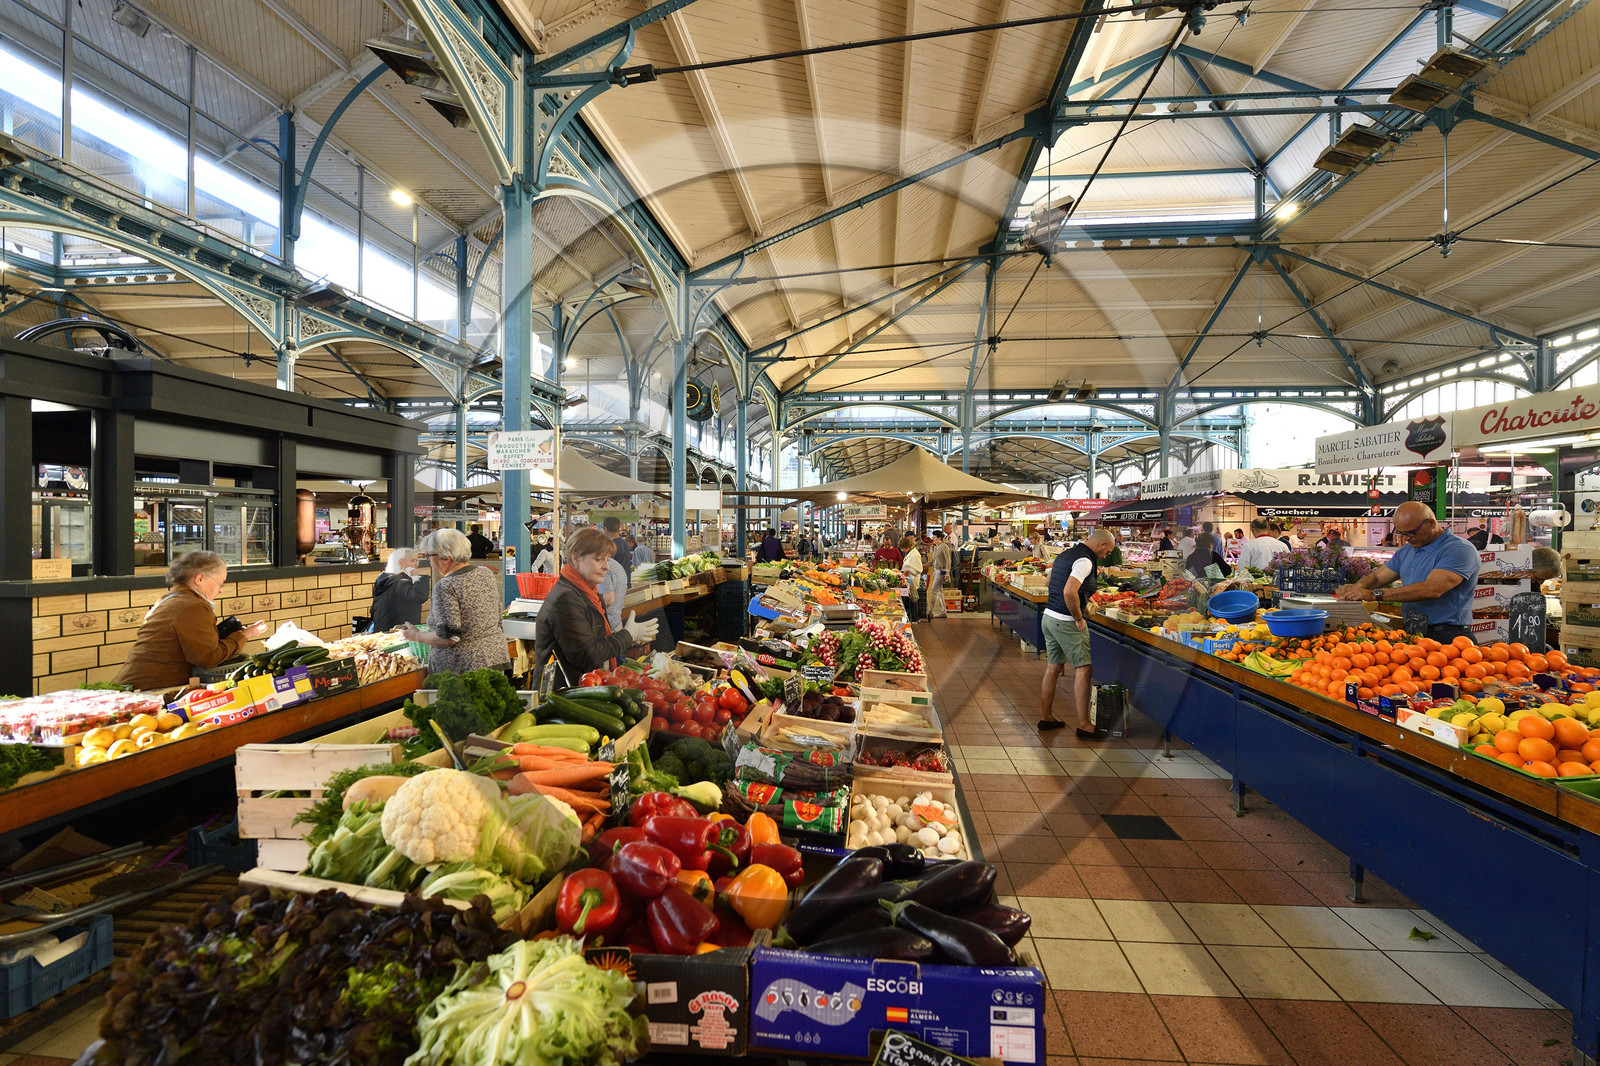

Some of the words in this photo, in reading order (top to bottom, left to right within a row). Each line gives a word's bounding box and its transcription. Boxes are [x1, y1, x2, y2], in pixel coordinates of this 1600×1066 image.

[1318, 440, 1351, 454] MARCEL
[1354, 431, 1401, 448] SABATIER
[1318, 454, 1349, 466] Boucherie
[1357, 448, 1401, 460] Charcuterie
[1261, 508, 1319, 516] Boucherie
[758, 654, 776, 664] TROPS
[191, 701, 211, 712] TOMATES
[217, 696, 228, 705] PAYS
